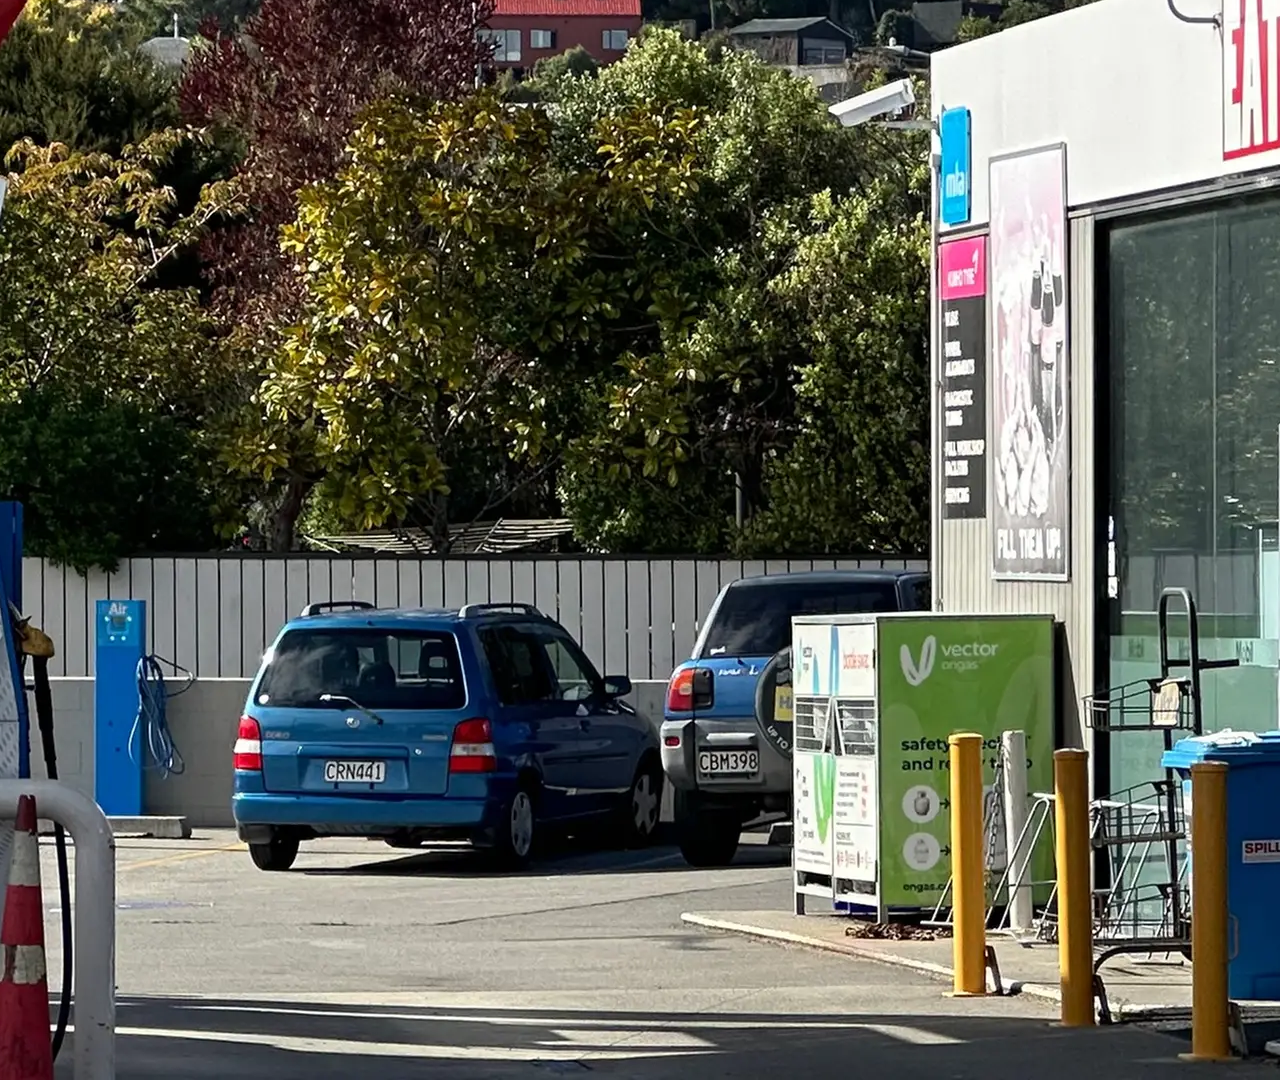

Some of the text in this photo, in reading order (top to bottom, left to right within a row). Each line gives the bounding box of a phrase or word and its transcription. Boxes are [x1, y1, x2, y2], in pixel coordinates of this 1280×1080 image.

[997, 528, 1017, 560] FILL
[1019, 527, 1044, 560] THEM
[110, 602, 128, 615] Air
[940, 641, 999, 658] vector
[941, 660, 979, 673] ongas
[901, 737, 950, 752] safety
[699, 752, 758, 771] CBM398
[902, 757, 933, 771] and
[326, 762, 382, 780] CRN441
